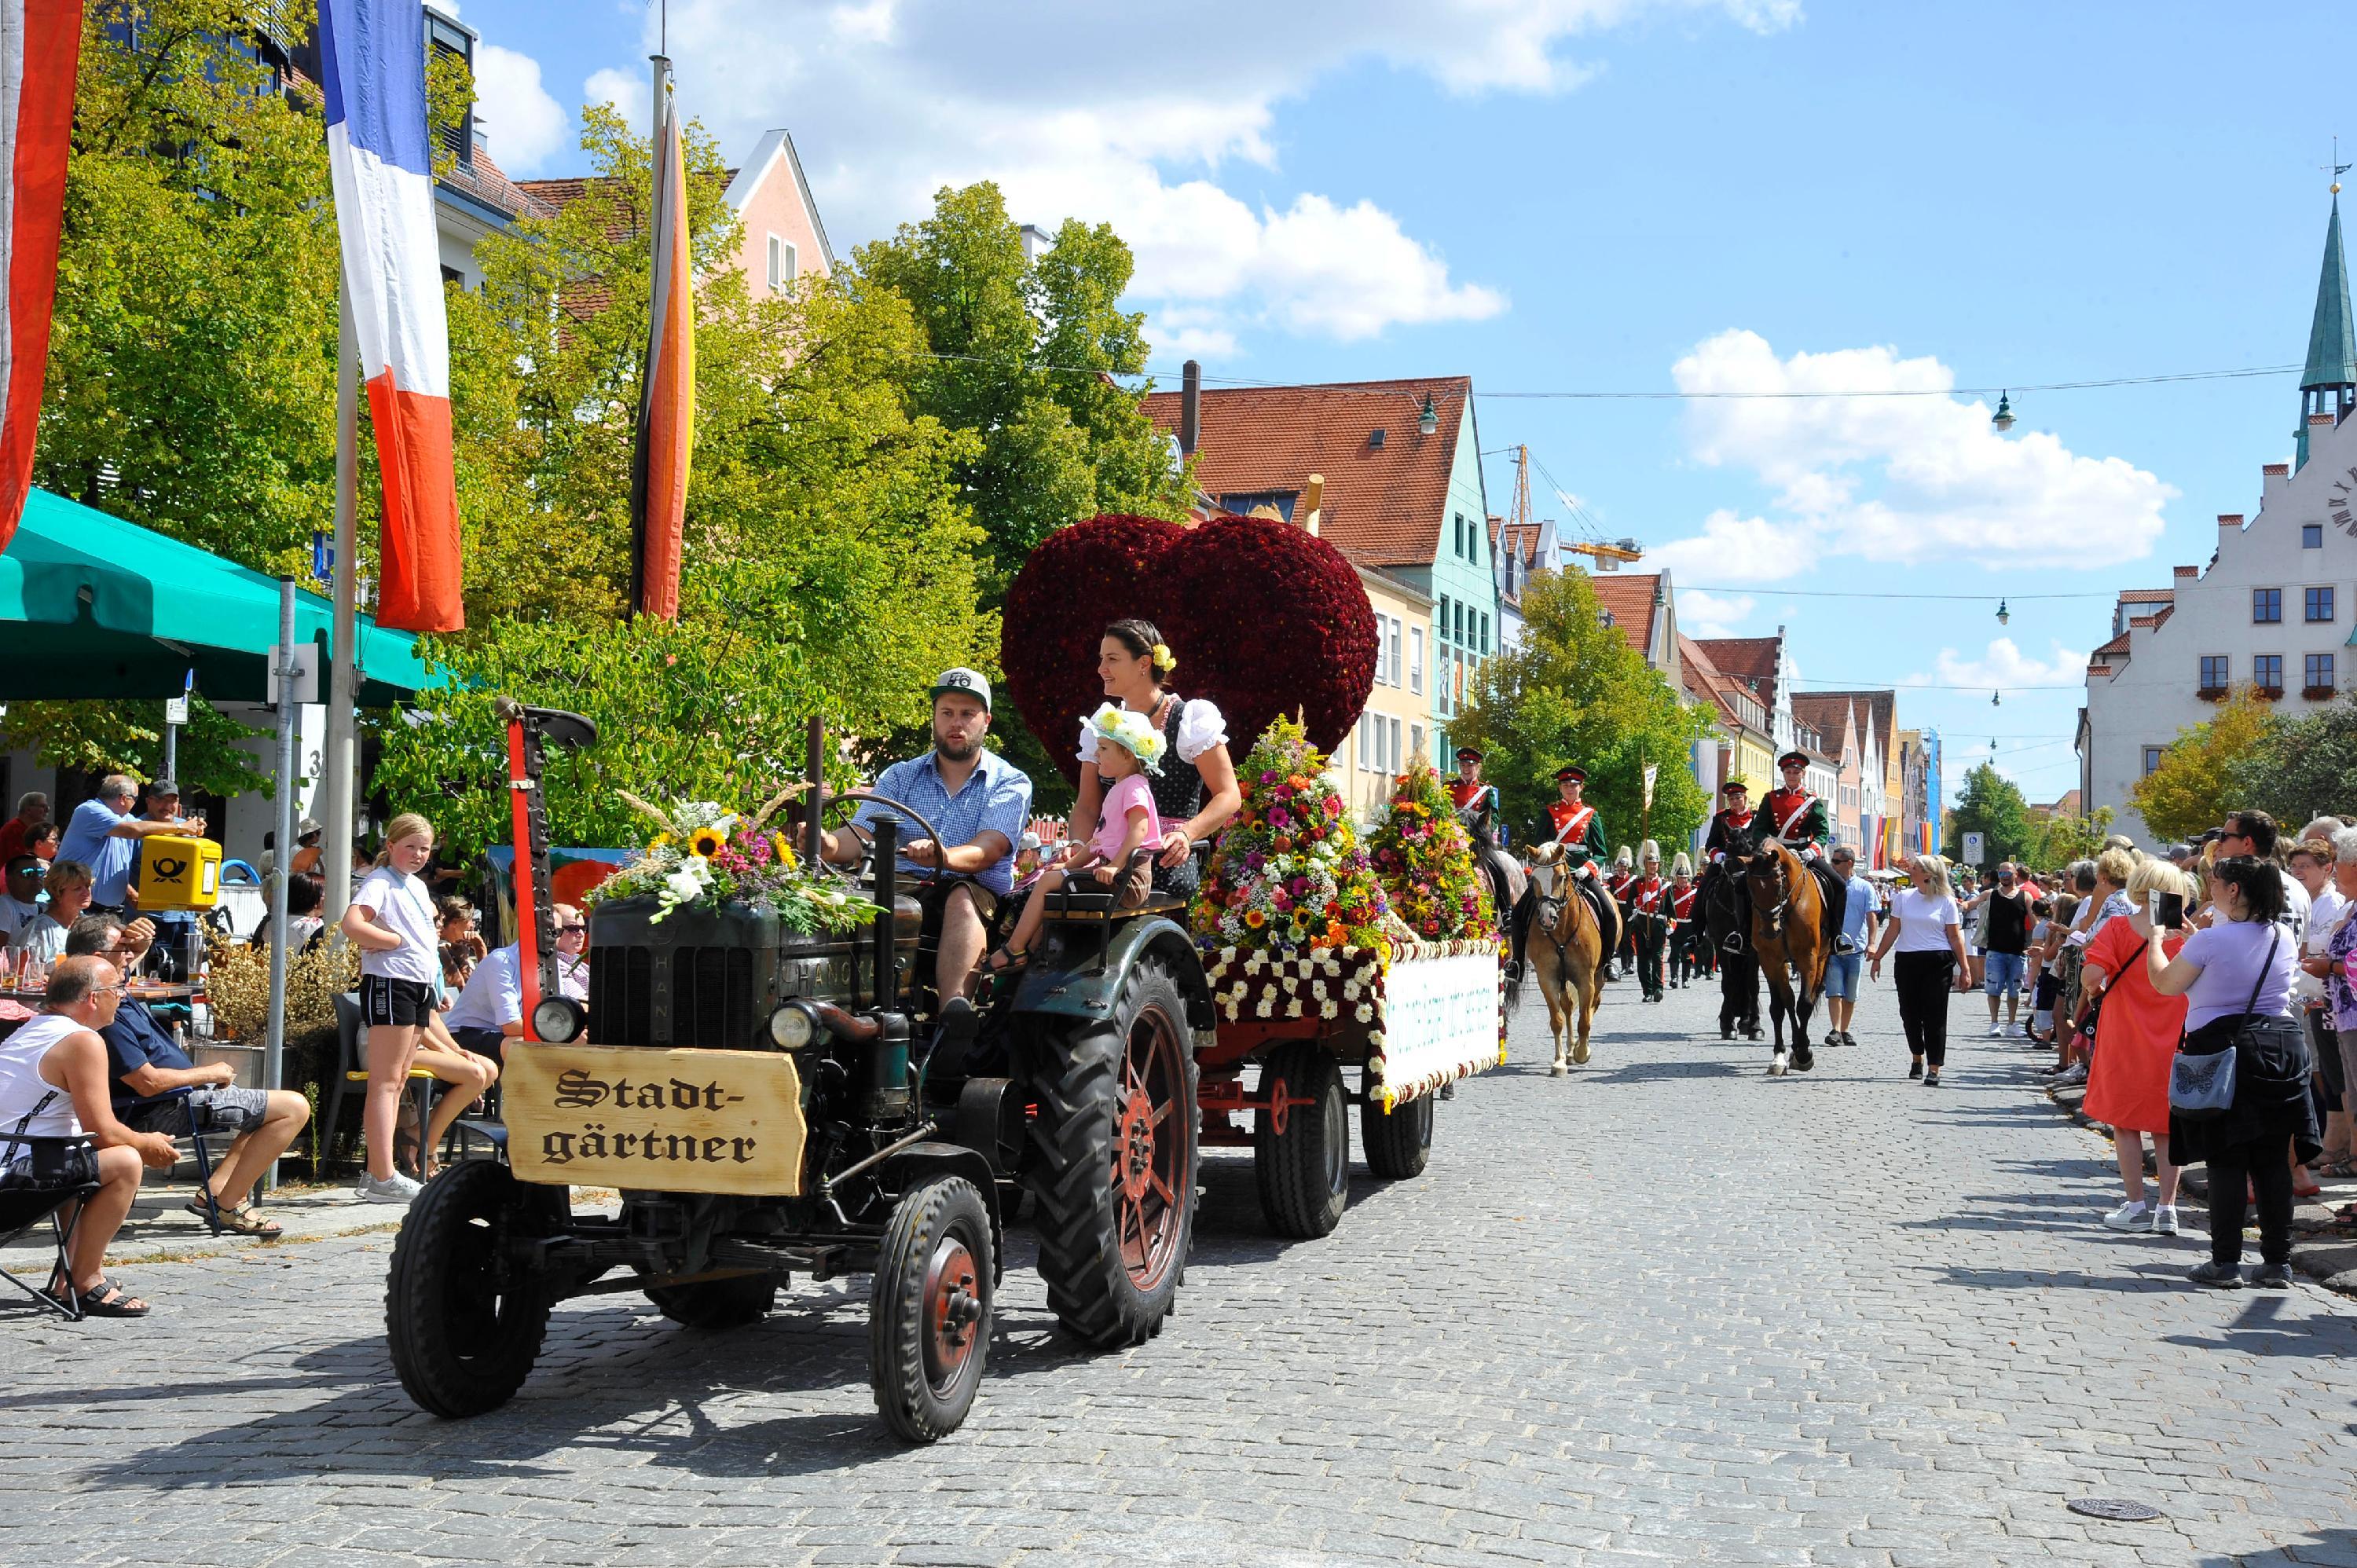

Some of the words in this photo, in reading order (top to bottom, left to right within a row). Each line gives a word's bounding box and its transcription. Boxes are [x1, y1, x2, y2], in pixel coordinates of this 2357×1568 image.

[310, 749, 321, 775] 3
[376, 991, 386, 1015] GIRL
[554, 1068, 745, 1112] Stadt-
[541, 1123, 757, 1164] gärtner
